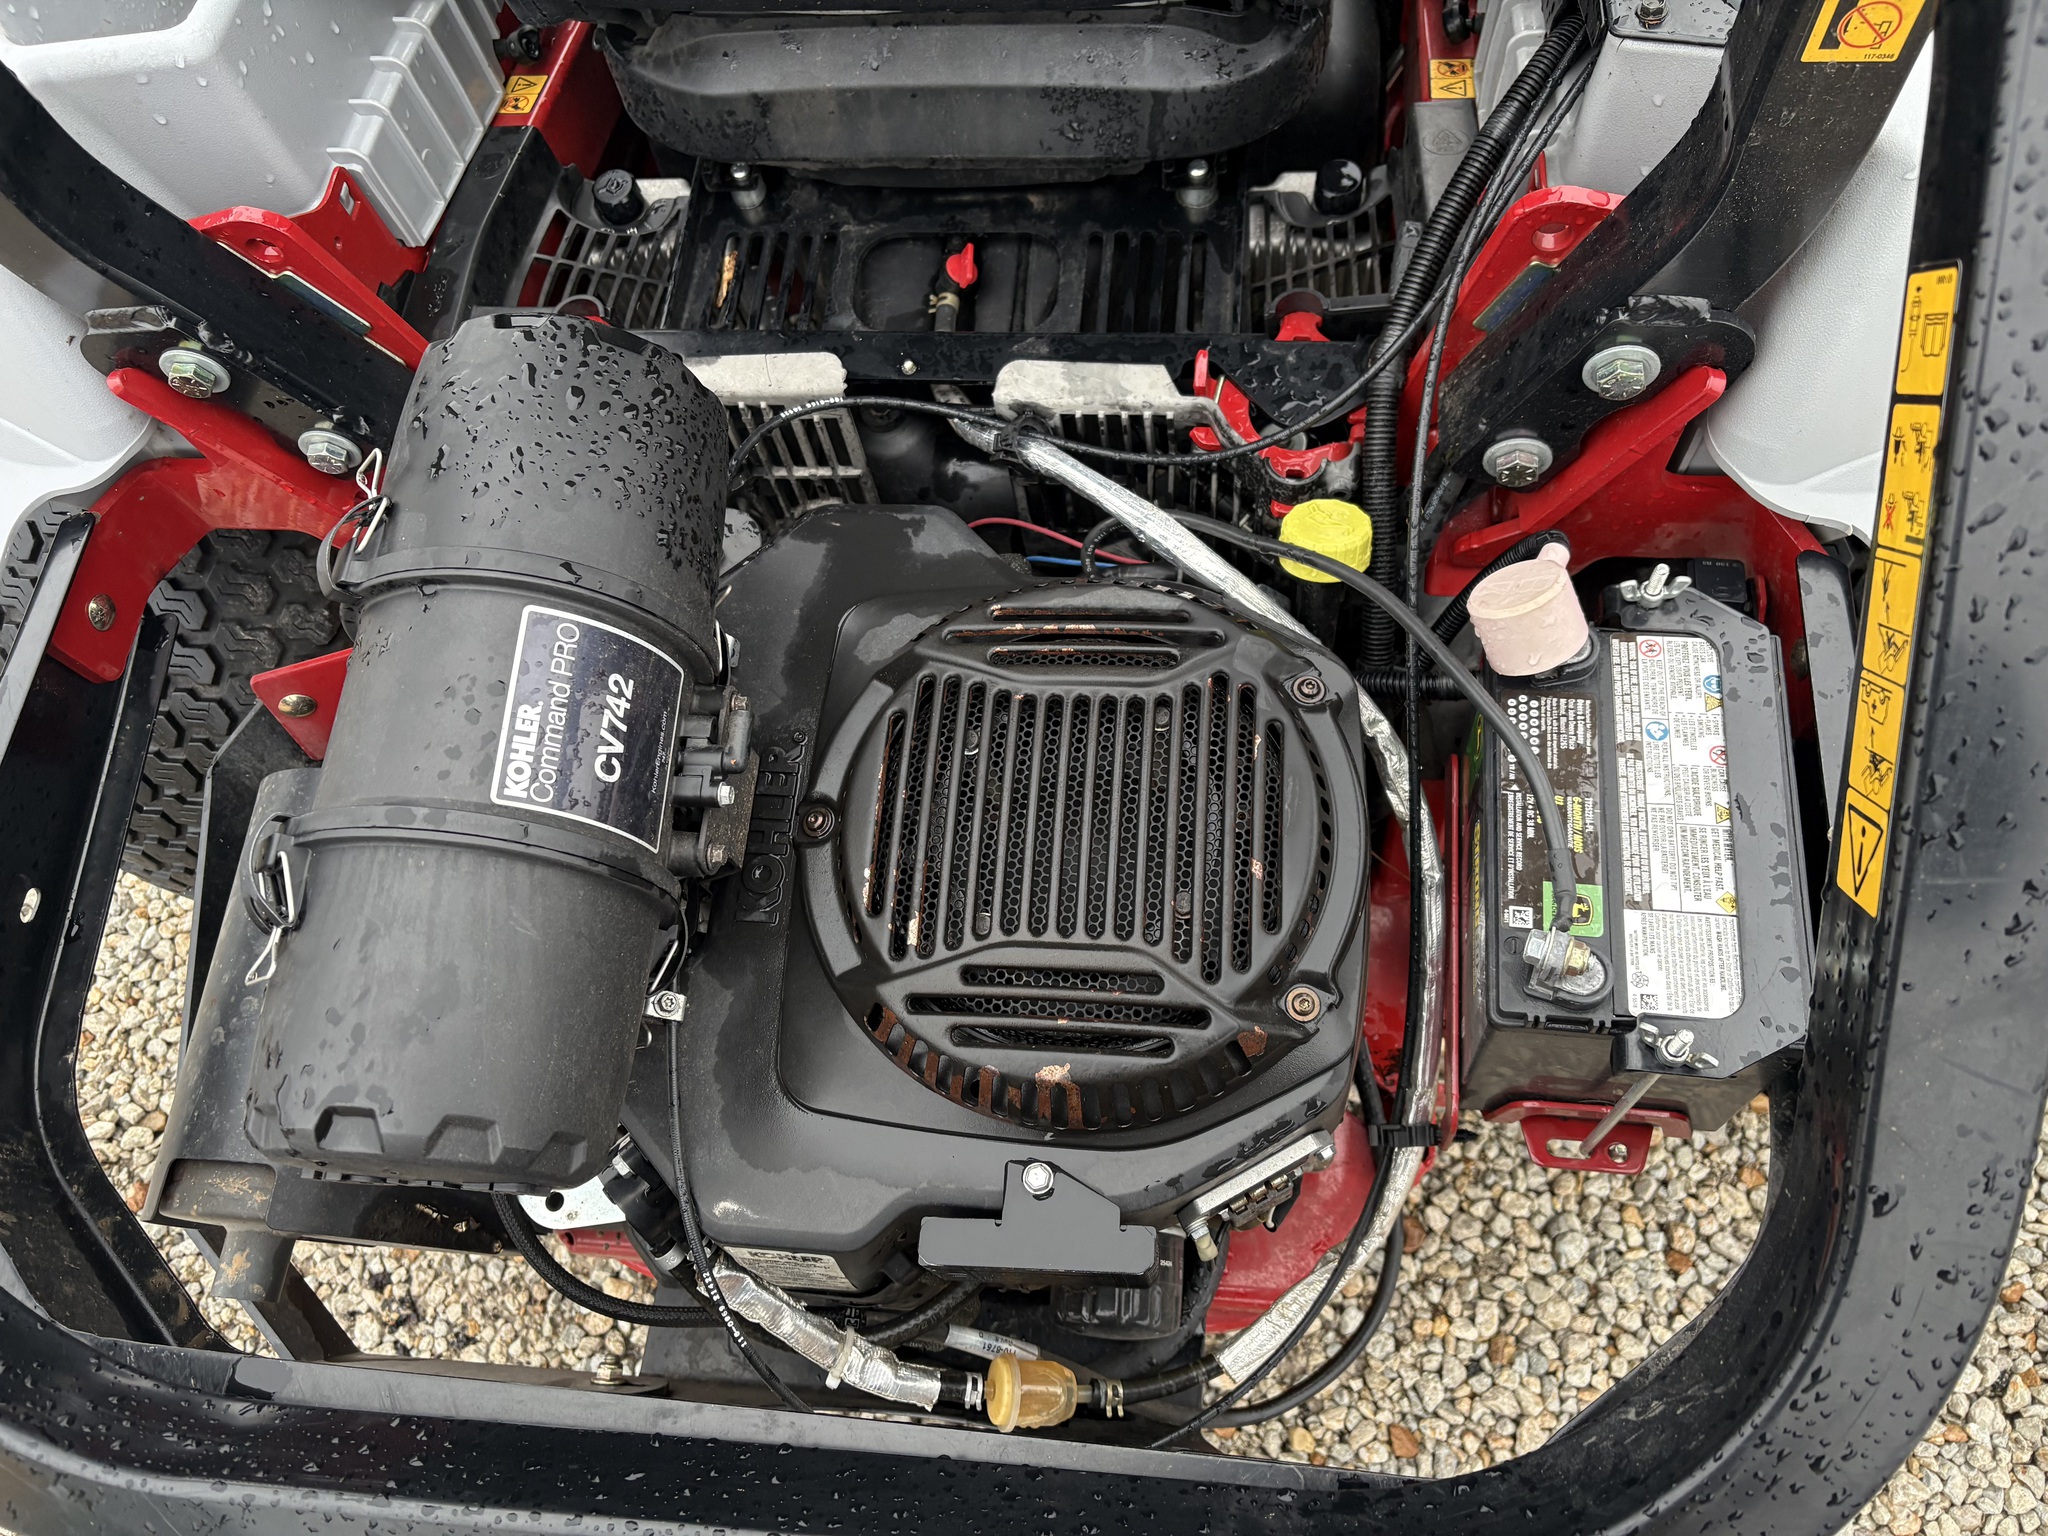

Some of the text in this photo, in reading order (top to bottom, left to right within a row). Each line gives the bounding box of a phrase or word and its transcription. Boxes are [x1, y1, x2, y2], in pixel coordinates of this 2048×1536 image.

[529, 622, 580, 803] Command PRO
[593, 672, 635, 784] CV742
[1567, 720, 1575, 734] Deere
[651, 710, 668, 794] KohlerEngines.com
[1526, 809, 1533, 817] RC
[1572, 796, 1582, 829] 6-MONTH
[1573, 834, 1583, 853] MOIS
[1711, 828, 1723, 891] GET MEDICAL HELP FAST.
